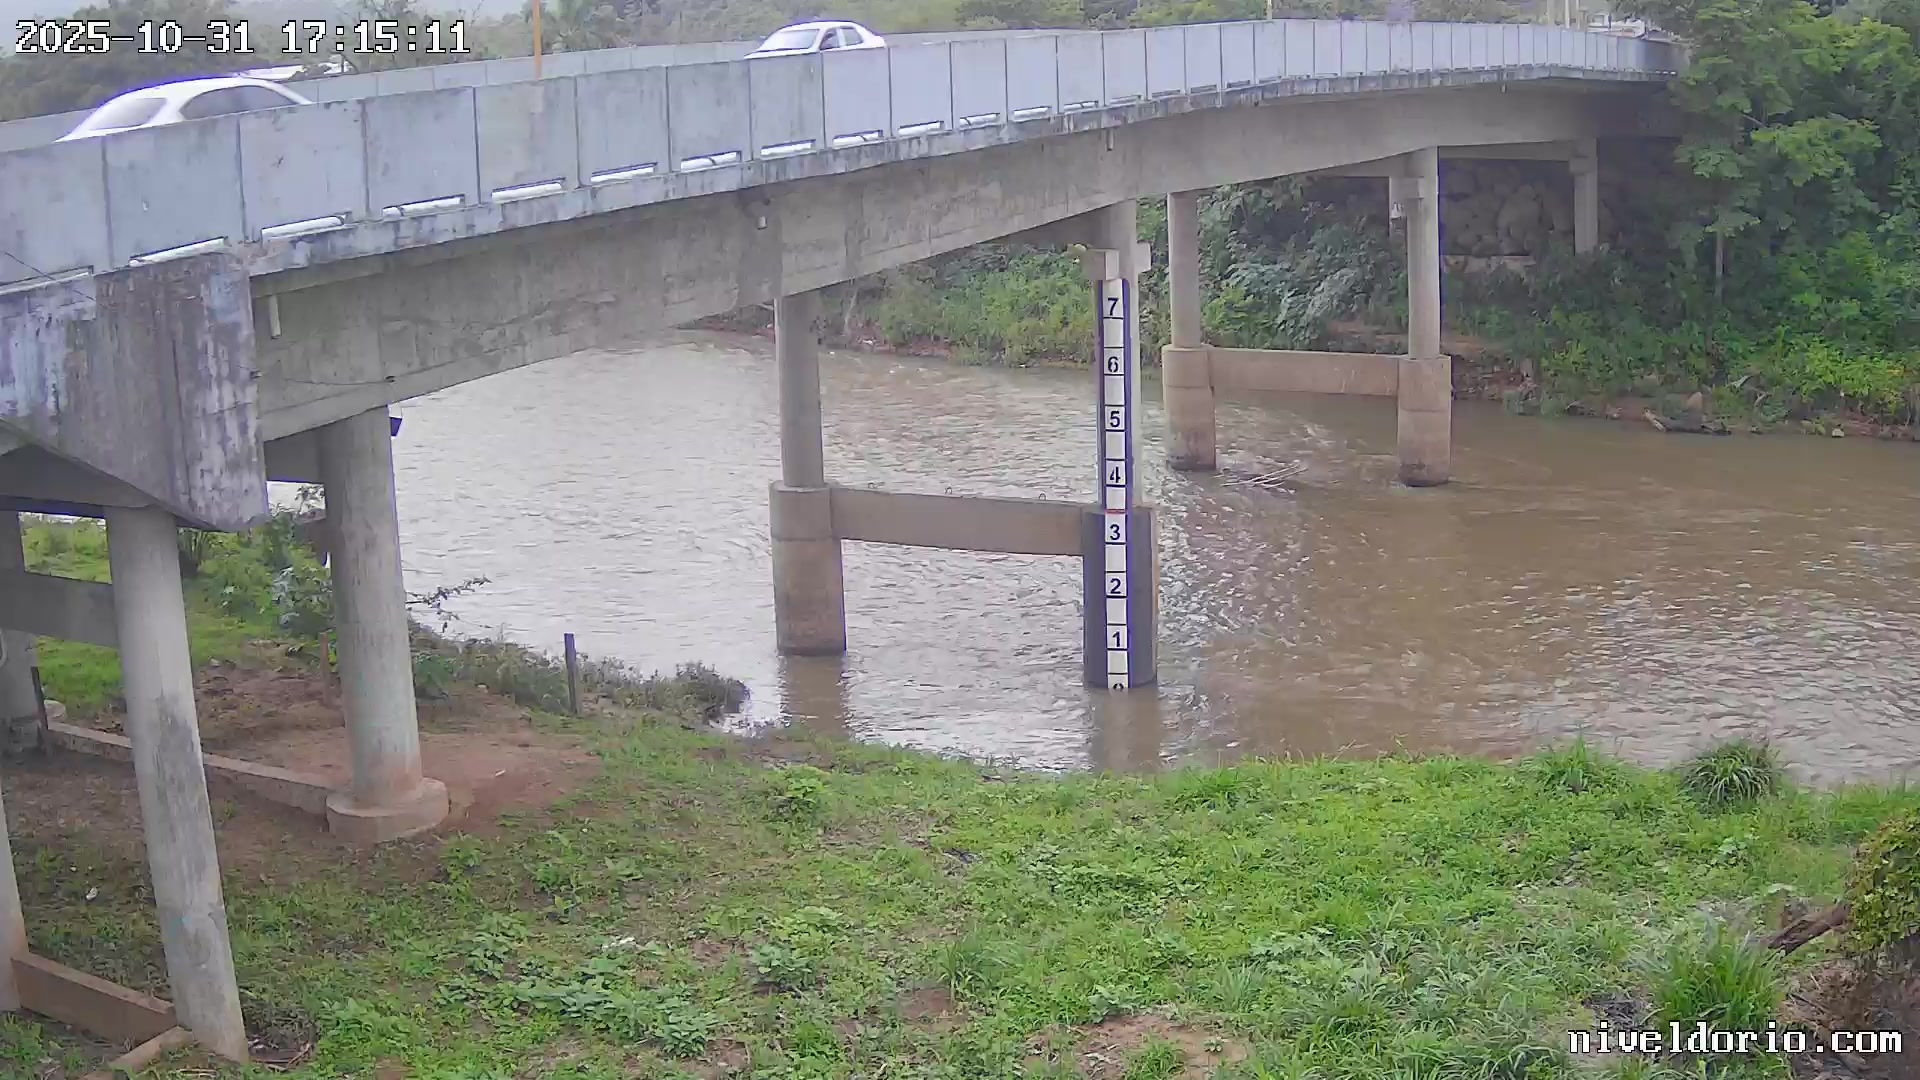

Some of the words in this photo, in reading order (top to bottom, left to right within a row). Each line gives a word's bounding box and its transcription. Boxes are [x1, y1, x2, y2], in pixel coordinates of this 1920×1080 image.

[1107, 297, 1120, 316] 7
[1107, 356, 1119, 373] 6
[1110, 410, 1120, 428] 5
[1109, 466, 1121, 484] 4
[1109, 524, 1121, 541] 3
[1110, 578, 1122, 594] 2
[1112, 631, 1121, 648] 1
